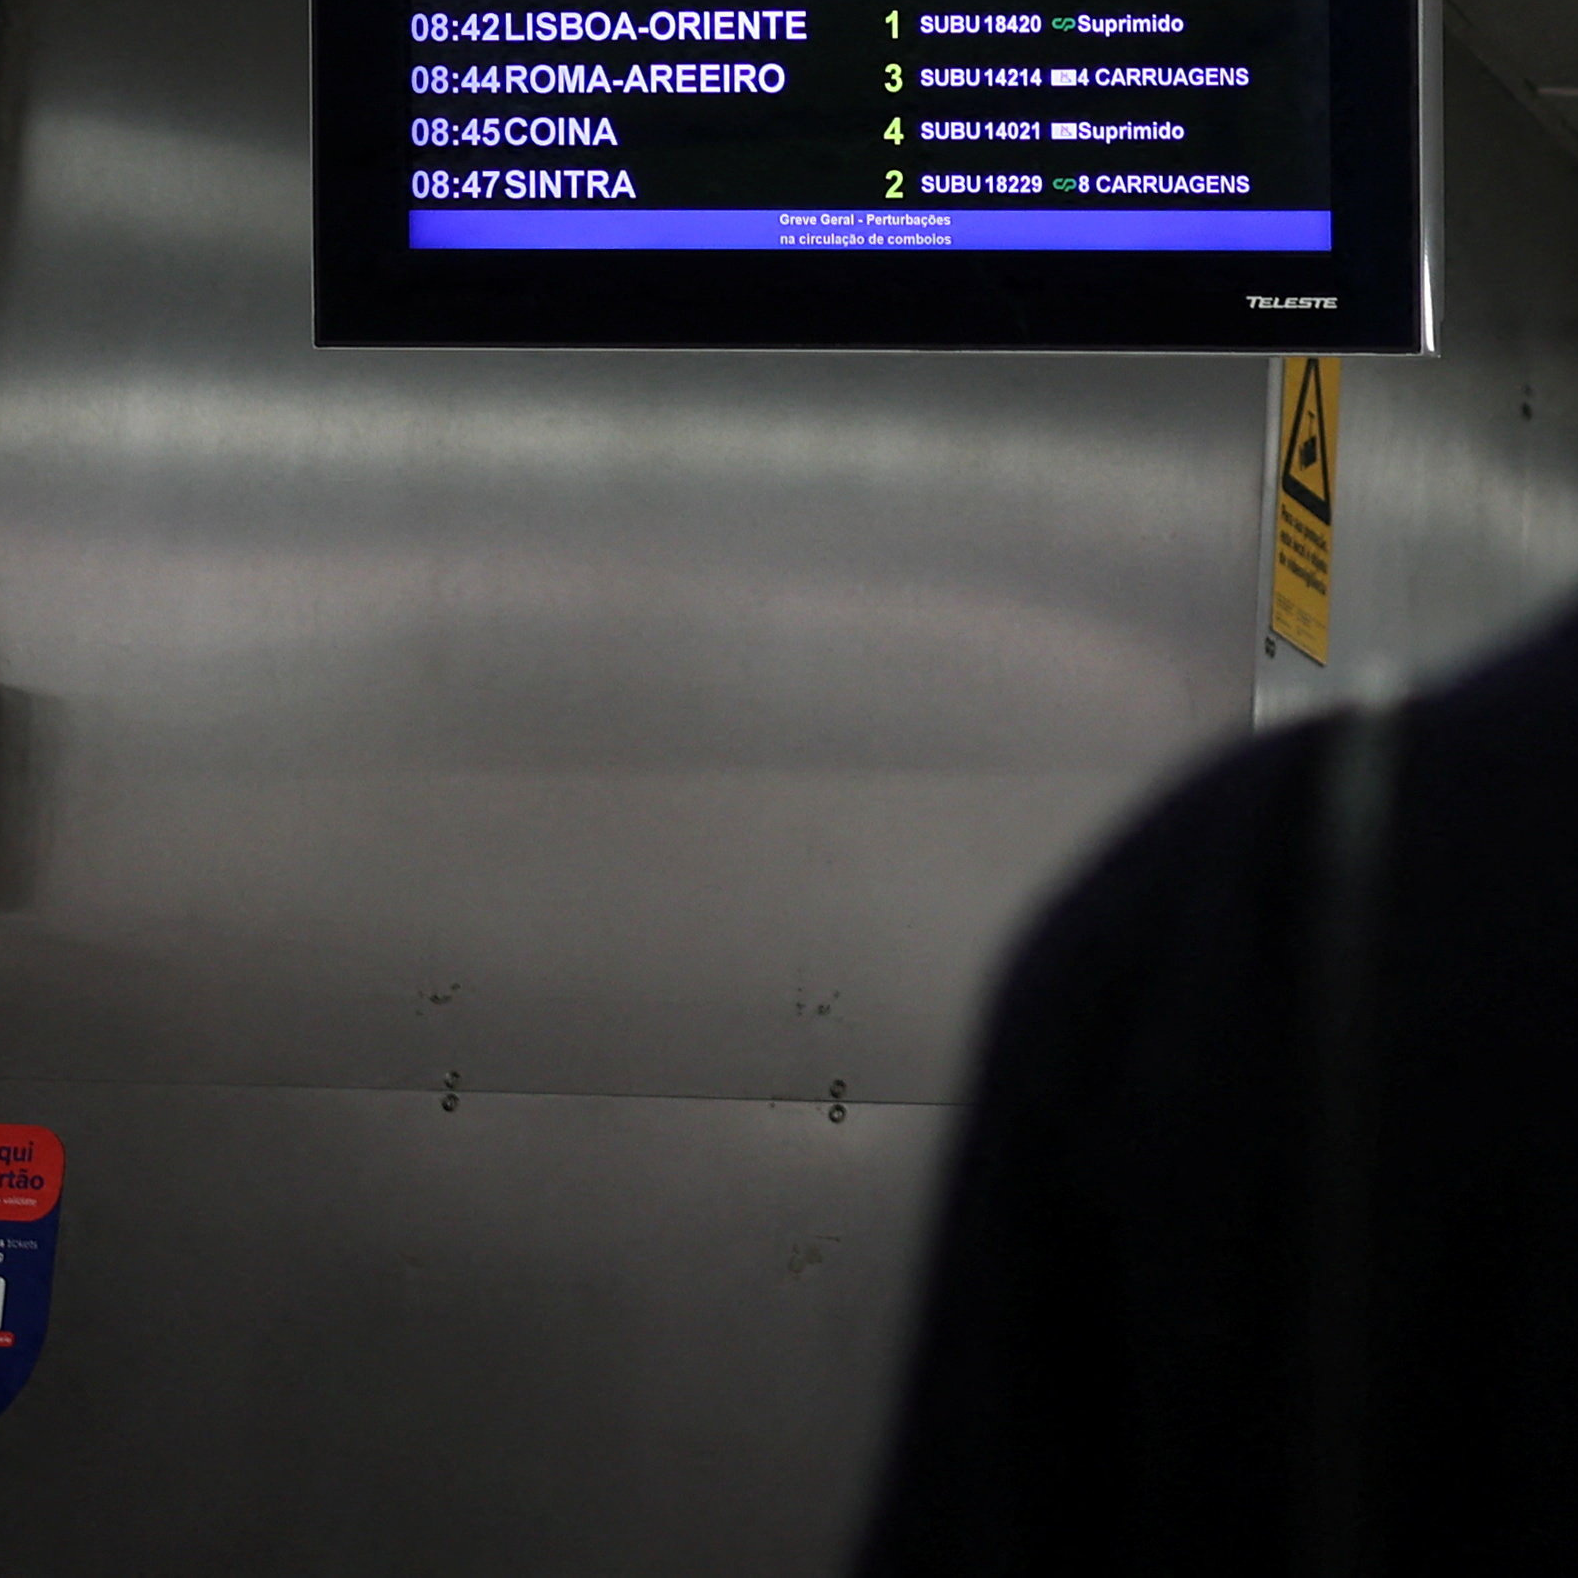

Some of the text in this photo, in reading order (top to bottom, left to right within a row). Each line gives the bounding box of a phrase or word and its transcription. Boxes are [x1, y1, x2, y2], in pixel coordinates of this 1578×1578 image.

[412, 10, 1183, 41] 08:42 LISBOA-ORIENTE 1 SUBU 18420 Suprimido
[412, 64, 1249, 93] 08:44 ROMA-AREEIRO 3 SUBU 14214 4 CARRUAGENS
[412, 117, 1184, 146] 08:45 COINA 4 SUBU 14021 Suprimido
[413, 170, 1249, 198] 08:47 SINTRA 2 SUBU 18229 8 CARRUAGENS
[779, 213, 817, 226] Greve
[820, 213, 855, 226] Geral
[866, 213, 951, 228] Perturbações
[779, 233, 952, 247] na circulação de comboios
[1246, 295, 1338, 309] TELESTE
